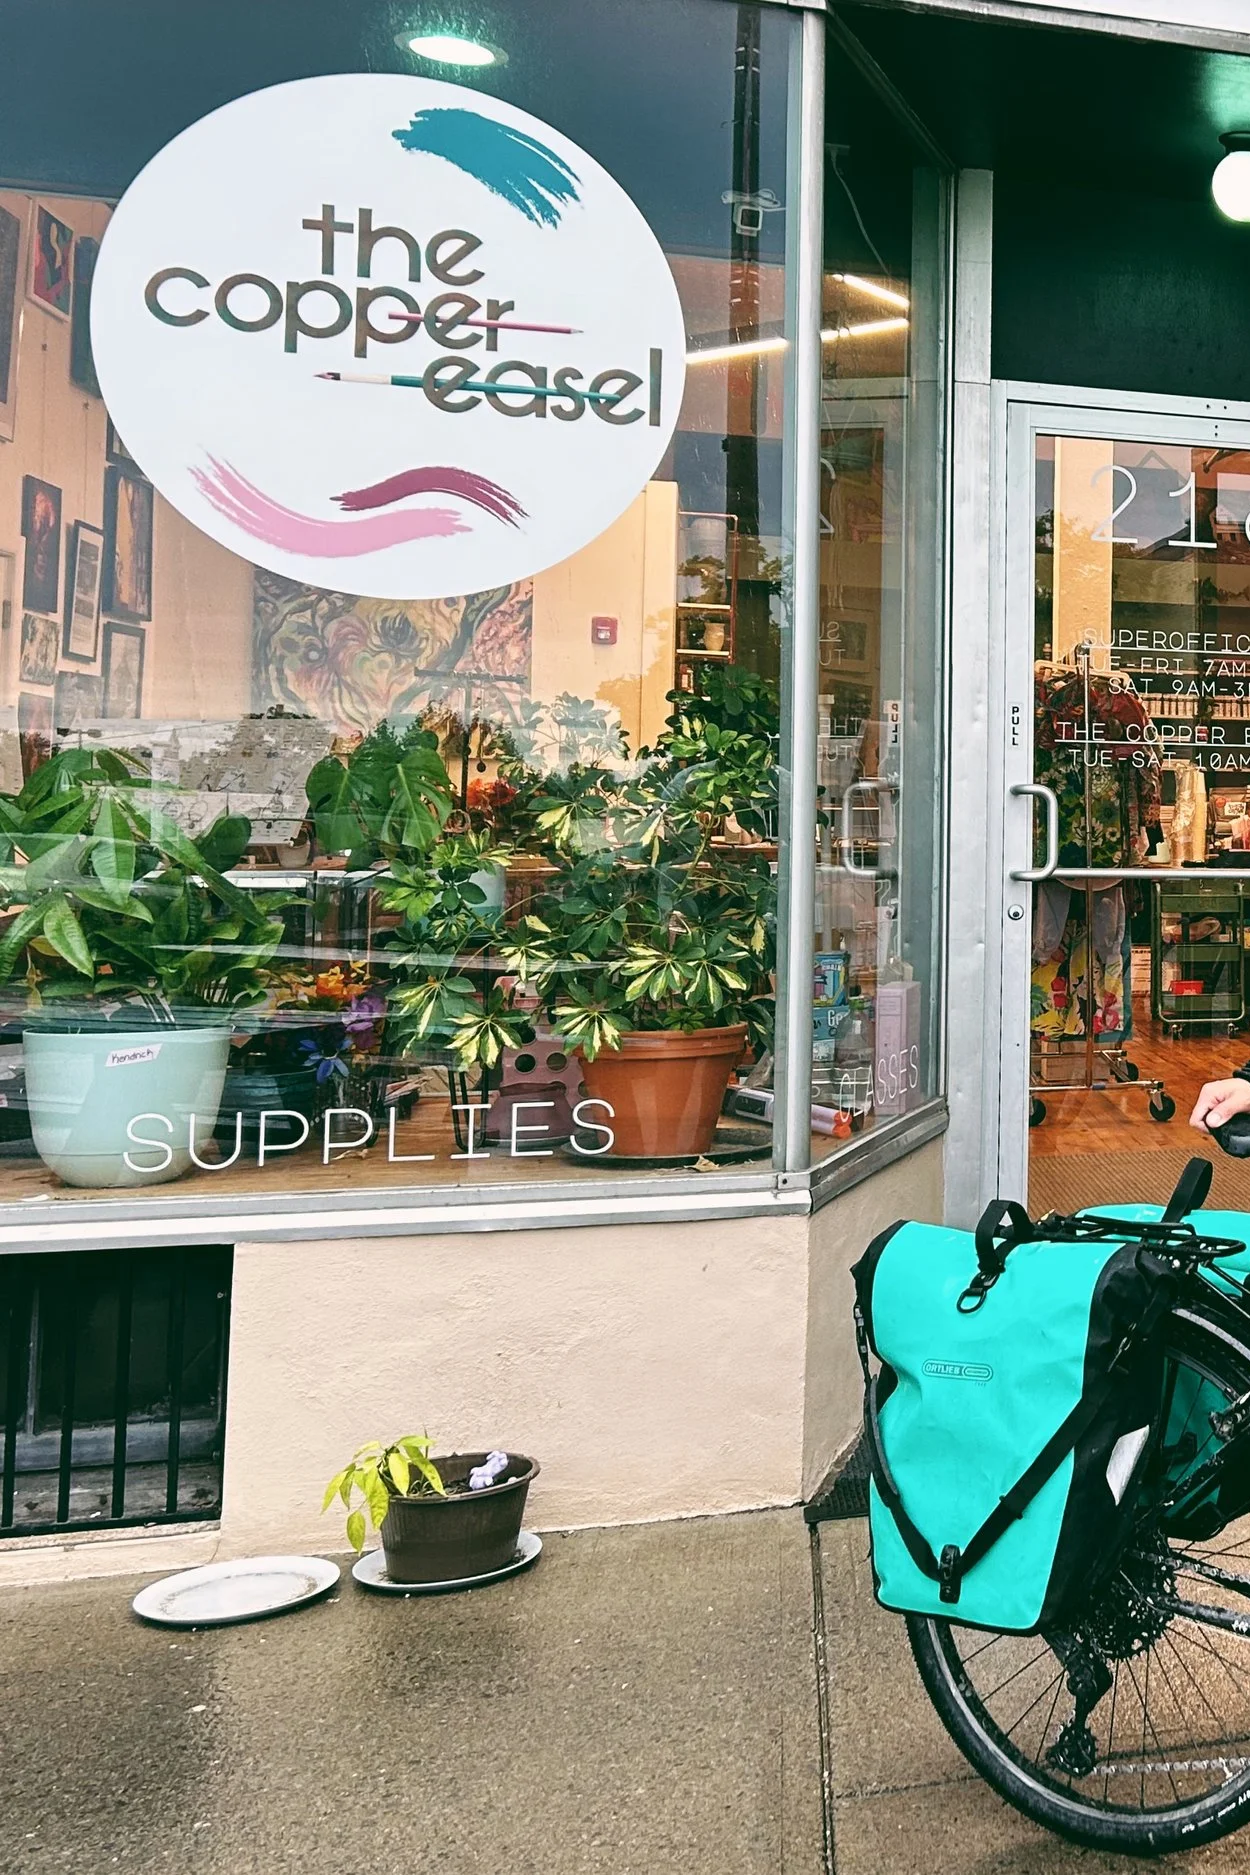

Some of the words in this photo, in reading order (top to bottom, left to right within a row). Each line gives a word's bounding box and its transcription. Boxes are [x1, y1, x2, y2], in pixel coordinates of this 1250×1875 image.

[302, 204, 488, 287] the
[144, 267, 516, 359] copper
[422, 347, 663, 428] easel
[1108, 678, 1154, 696] SAT
[1011, 706, 1020, 746] PULL
[1056, 722, 1106, 742] THE
[1126, 723, 1226, 745] COPPER
[1068, 749, 1177, 769] TUE-SAT
[839, 1044, 919, 1123] CLASSES
[122, 1097, 617, 1174] SUPPLIES
[924, 1363, 961, 1375] ORTLIEB
